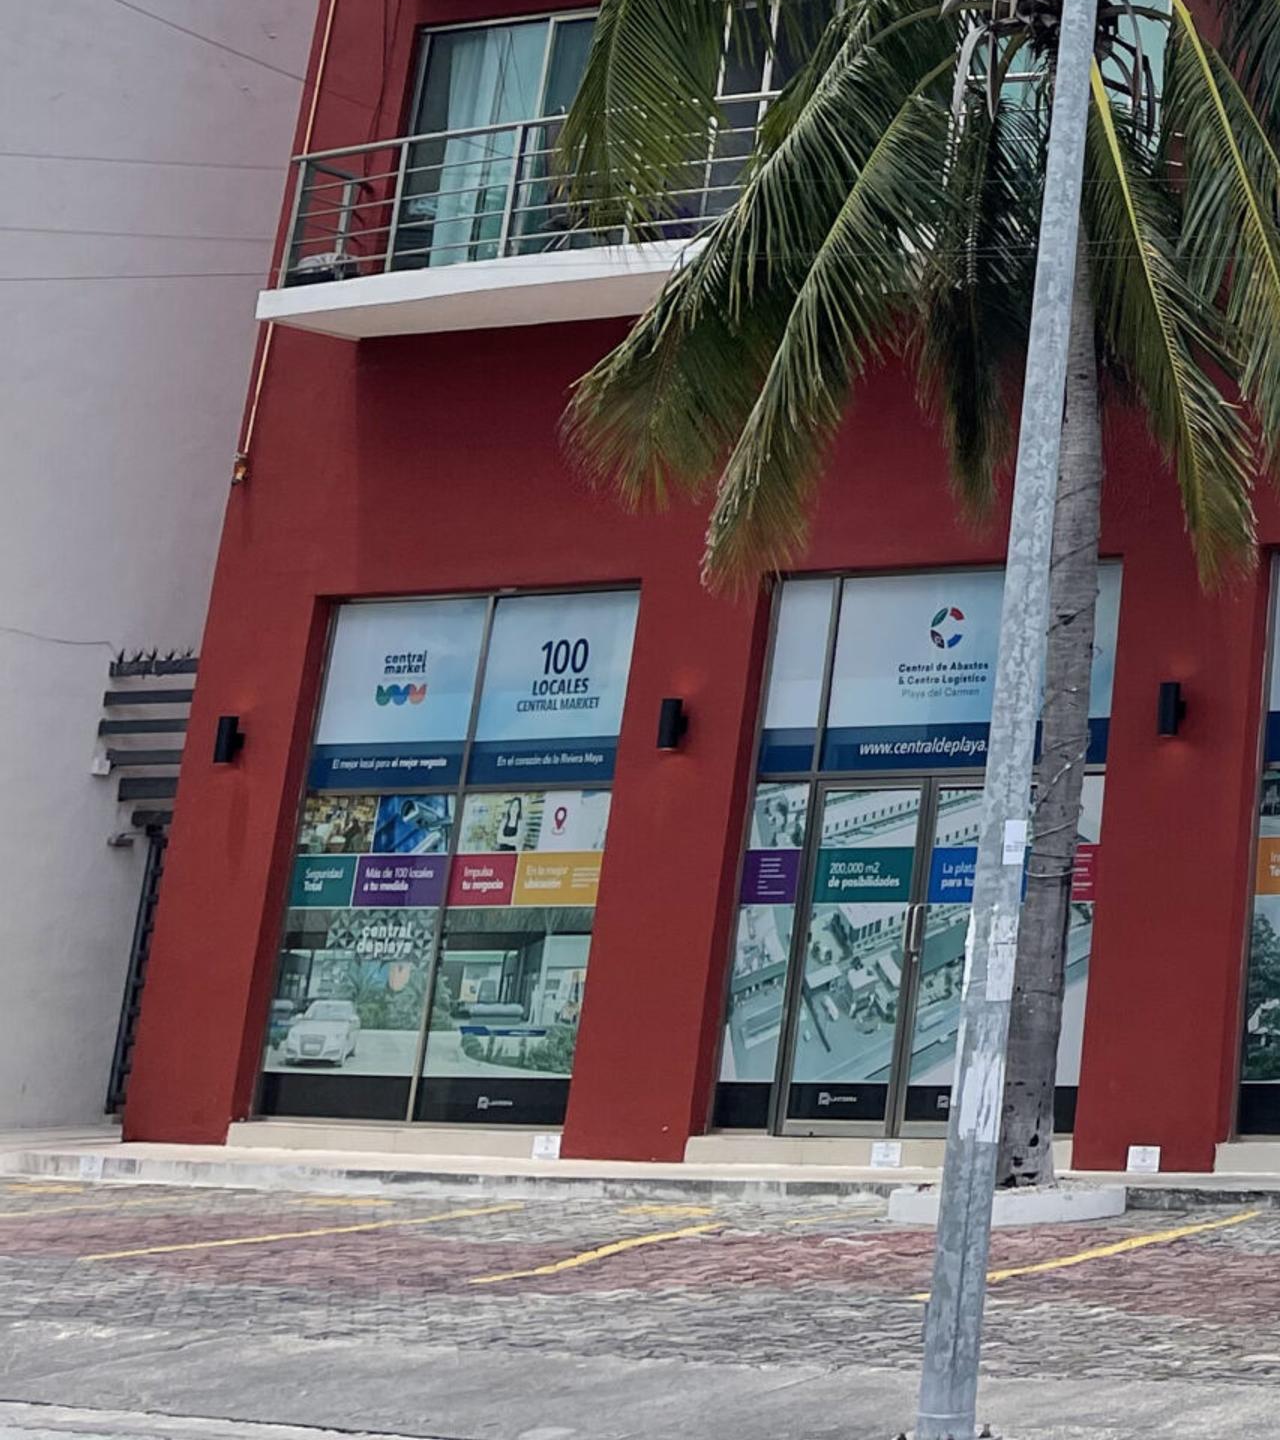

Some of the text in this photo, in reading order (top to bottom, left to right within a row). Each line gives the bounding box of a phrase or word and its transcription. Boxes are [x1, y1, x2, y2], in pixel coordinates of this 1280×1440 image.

[384, 650, 428, 664] central
[541, 638, 589, 675] 100
[384, 663, 426, 674] market
[898, 663, 934, 673] Central
[936, 662, 948, 671] de
[532, 677, 590, 696] LOCALES
[907, 675, 940, 685] Centro
[517, 696, 600, 712] CENTRAL MARKET
[860, 736, 988, 756] www.centraldeplaya.
[829, 862, 880, 875] 200,000 m2
[943, 863, 953, 875] La
[828, 874, 900, 890] de posibilidades
[941, 878, 962, 890] para
